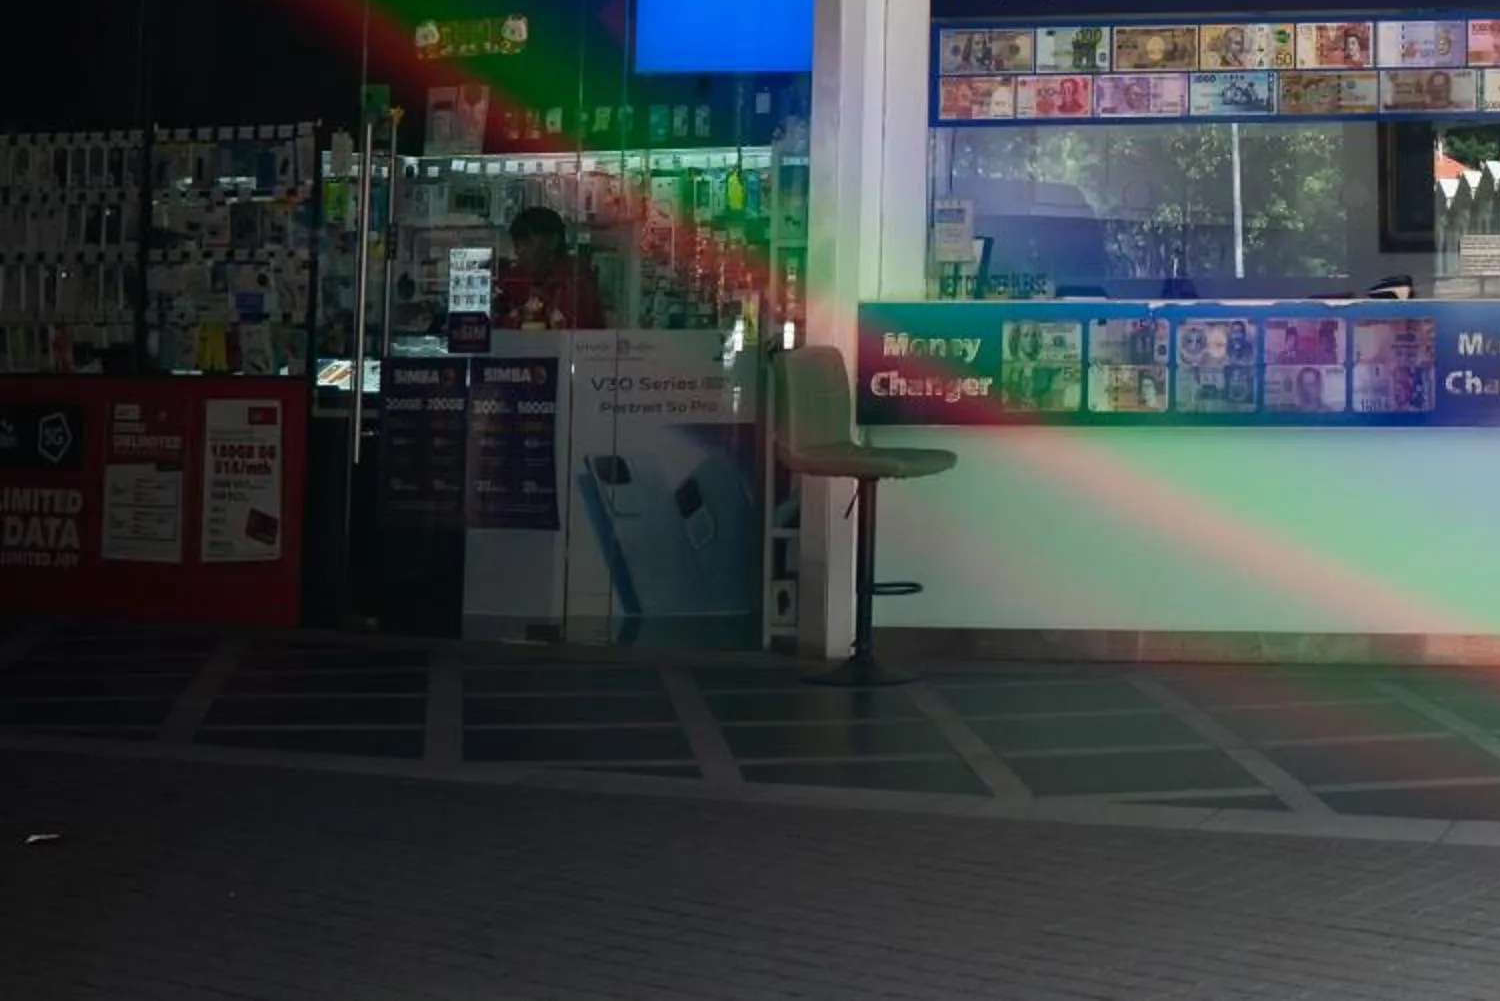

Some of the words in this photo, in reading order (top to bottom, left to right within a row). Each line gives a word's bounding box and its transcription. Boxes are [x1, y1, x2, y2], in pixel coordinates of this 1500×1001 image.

[881, 332, 982, 363] Money
[483, 367, 532, 383] SIMBA
[591, 376, 632, 391] V30
[639, 376, 697, 391] Series
[871, 370, 993, 404] Changer
[0, 487, 84, 514] IMITED
[3, 514, 81, 549] DATA
